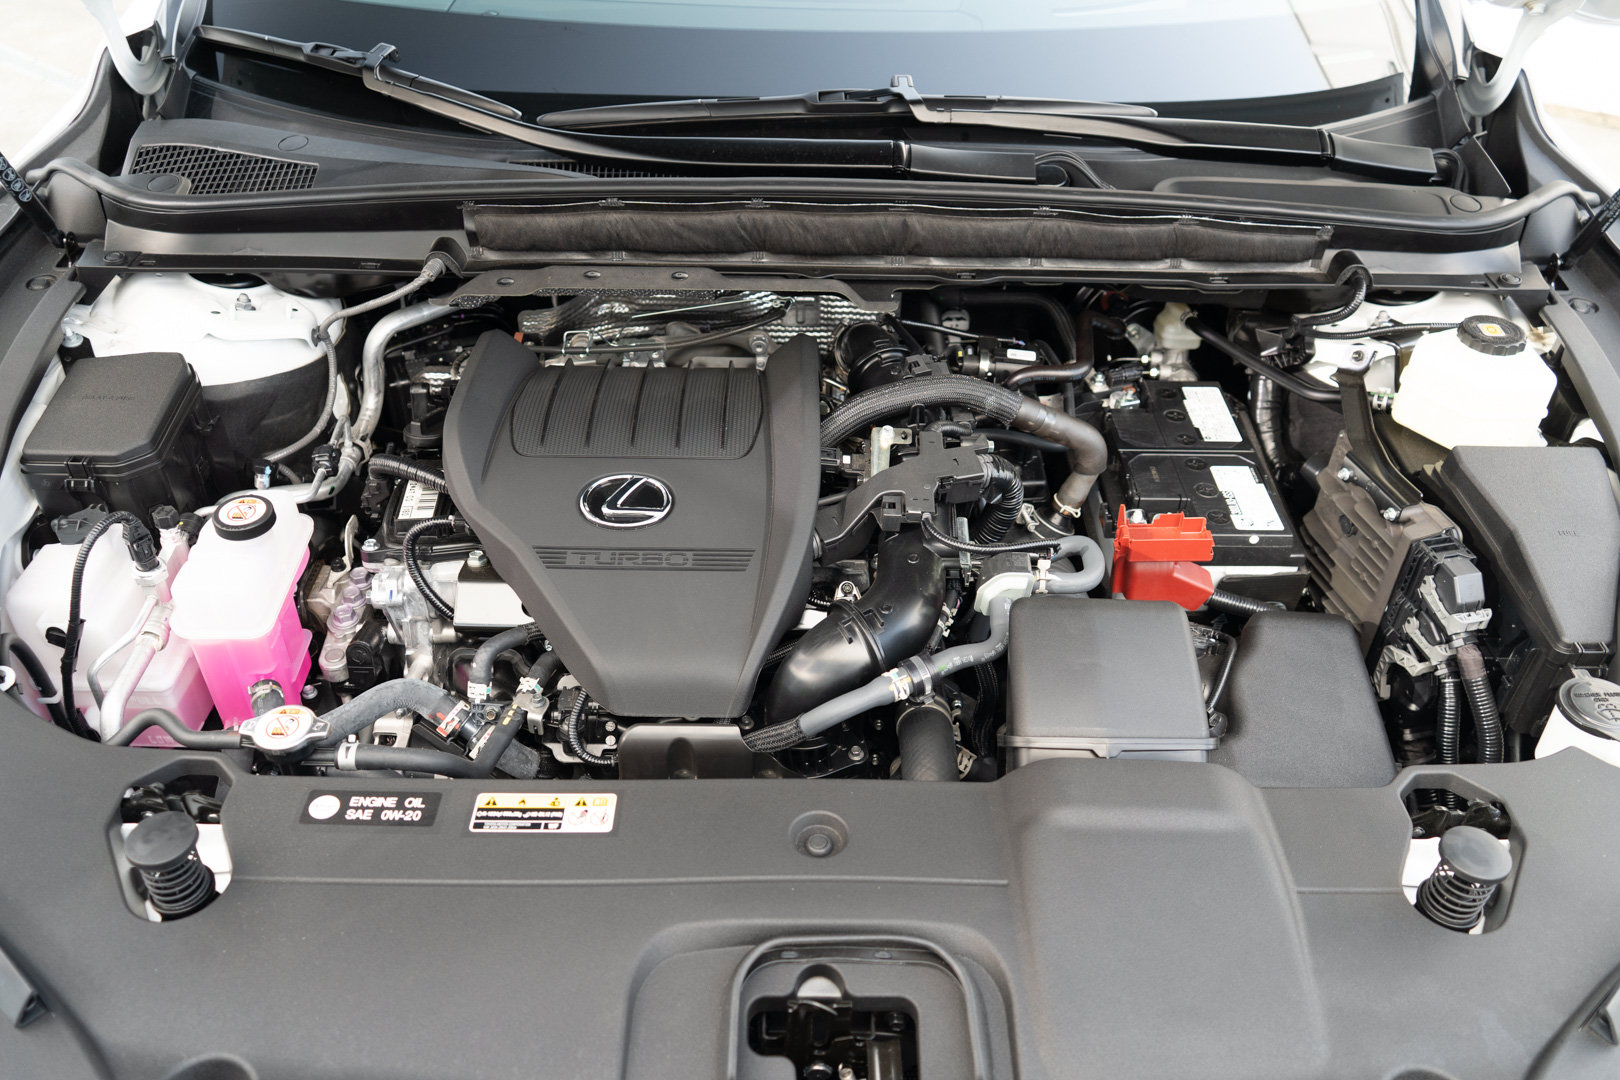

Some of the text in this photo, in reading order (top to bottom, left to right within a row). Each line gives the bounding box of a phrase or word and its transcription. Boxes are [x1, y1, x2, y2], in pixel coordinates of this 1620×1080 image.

[570, 551, 689, 566] TURBO
[349, 796, 425, 808] ENGINE OIL
[344, 808, 422, 821] SAE 0W-20
